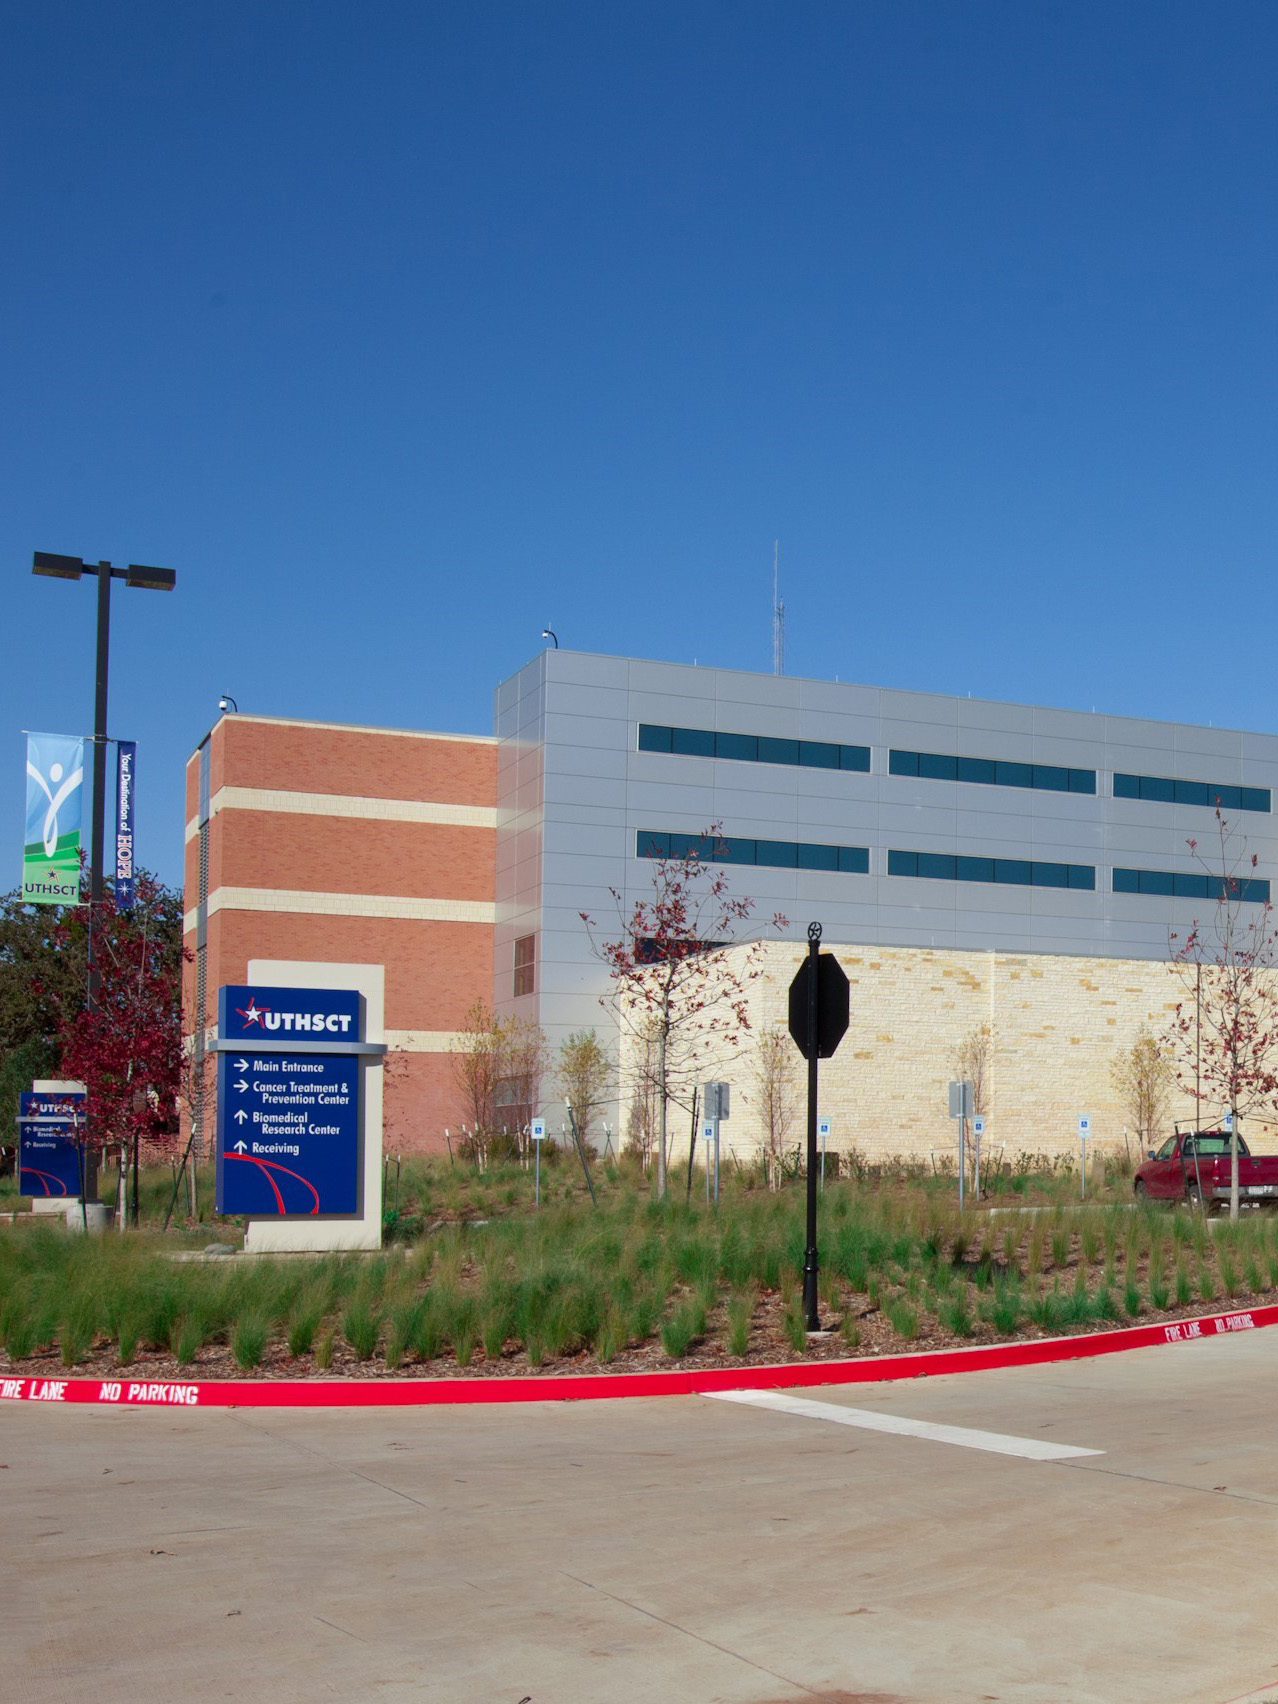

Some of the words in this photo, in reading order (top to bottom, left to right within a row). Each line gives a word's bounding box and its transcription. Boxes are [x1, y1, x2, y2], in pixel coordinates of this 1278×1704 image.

[121, 753, 132, 773] Your
[120, 773, 131, 821] Destination
[120, 821, 131, 832] of
[117, 834, 132, 879] HOPE
[25, 883, 76, 896] UTHSCT
[264, 1012, 351, 1032] UTHSCT
[253, 1060, 279, 1072] Main
[282, 1060, 324, 1073] Entrance
[253, 1081, 286, 1093] Cancer
[289, 1081, 338, 1093] Treatment
[341, 1082, 349, 1093] &
[262, 1093, 315, 1105] Prevention
[318, 1093, 350, 1105] Center
[252, 1111, 308, 1123] Biomedical
[262, 1123, 306, 1135] Research
[308, 1123, 340, 1135] Center
[252, 1142, 300, 1156] Receiving
[1164, 1325, 1184, 1343] FIRE
[1183, 1321, 1203, 1338] LANE
[1214, 1318, 1226, 1333] NO
[1226, 1313, 1255, 1331] PARKING
[28, 1380, 69, 1400] LANE
[99, 1382, 123, 1401] NO
[127, 1383, 199, 1405] PARKING
